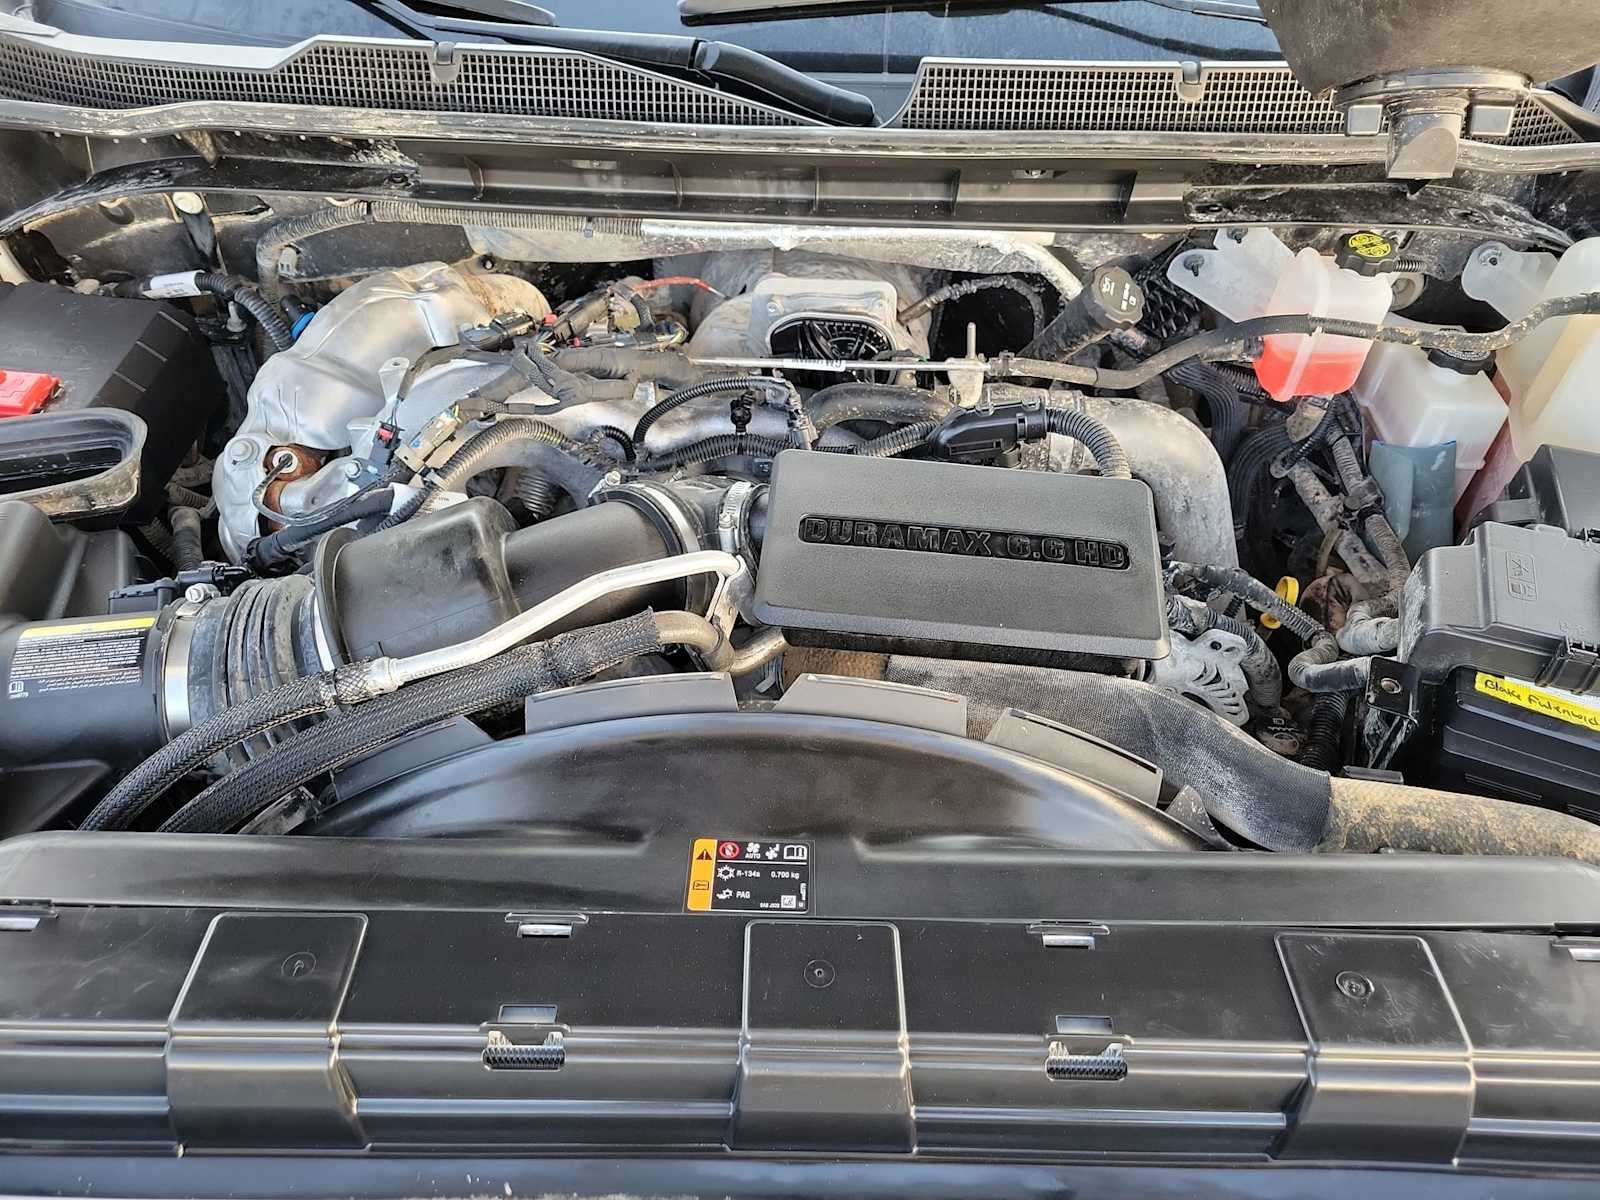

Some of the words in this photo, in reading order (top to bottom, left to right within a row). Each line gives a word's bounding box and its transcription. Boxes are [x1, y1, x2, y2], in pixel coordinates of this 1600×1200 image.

[804, 517, 992, 556] DURAMAX
[1007, 534, 1066, 561] 6.6
[1075, 540, 1126, 568] HD
[736, 869, 761, 878] R-134a
[770, 870, 790, 879] 0.700
[790, 871, 800, 880] kg
[736, 890, 751, 899] PAG
